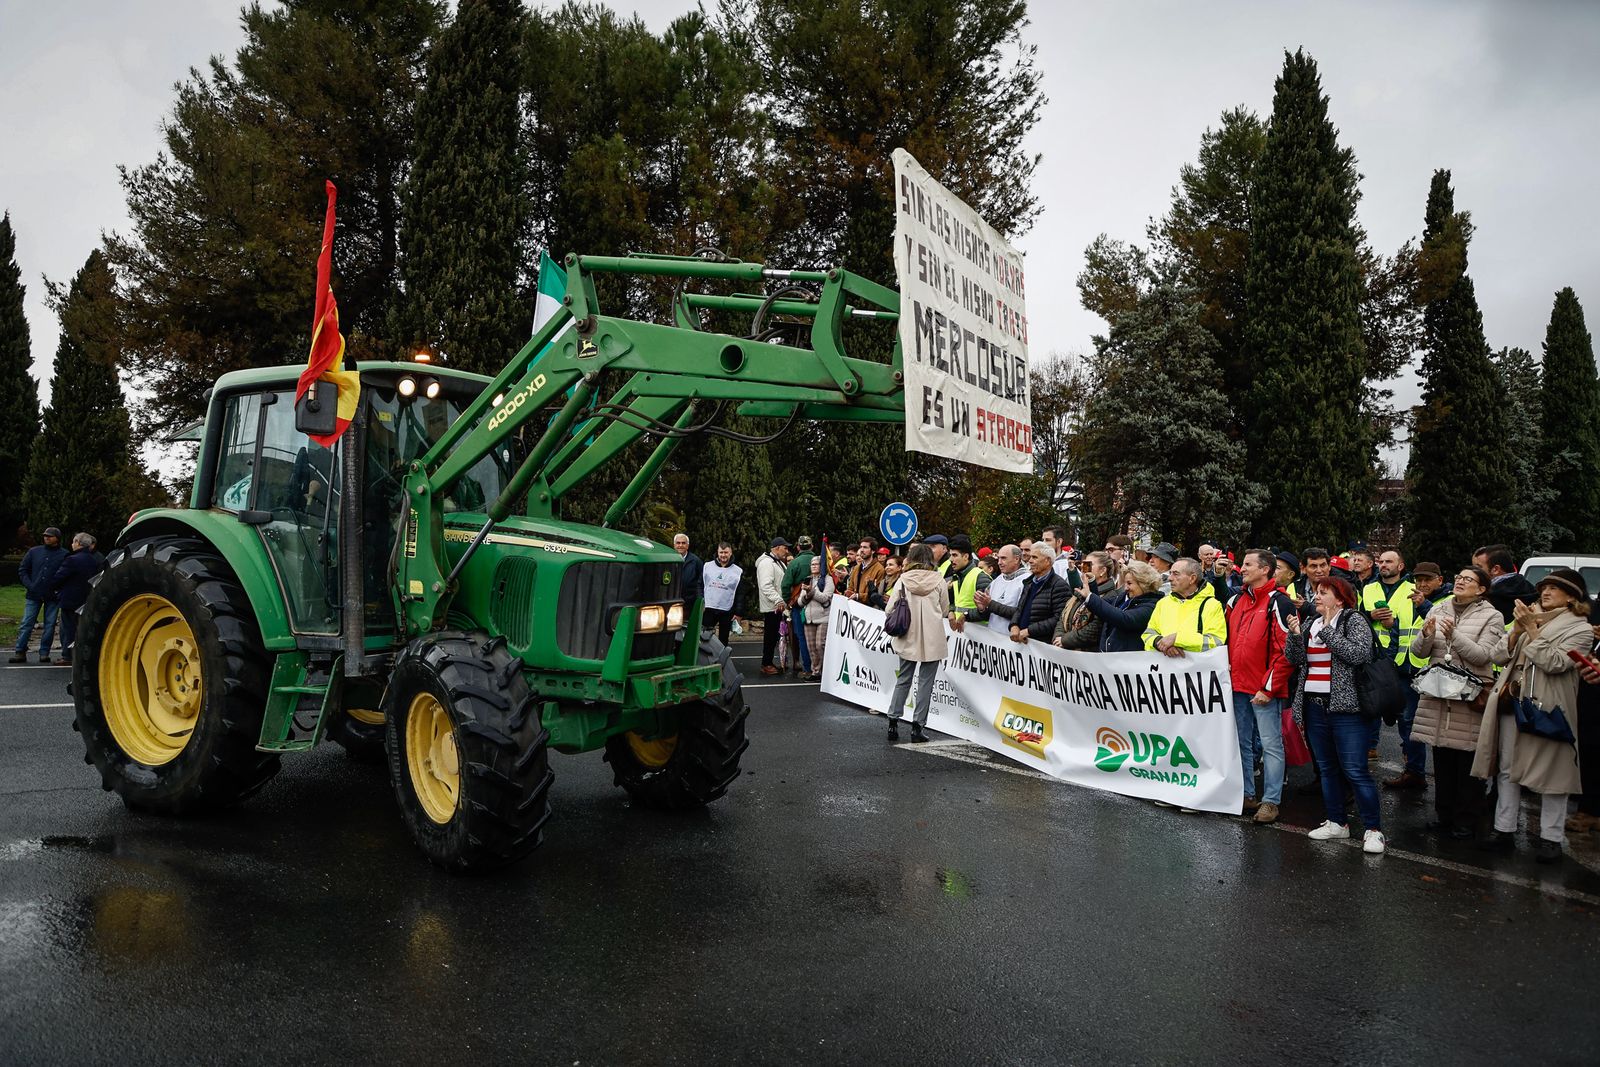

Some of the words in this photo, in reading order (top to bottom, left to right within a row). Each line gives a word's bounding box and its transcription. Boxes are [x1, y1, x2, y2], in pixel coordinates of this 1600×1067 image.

[901, 174, 925, 225] SIN
[928, 196, 950, 245] LAS
[954, 217, 990, 275] MISMAS
[993, 250, 1025, 300] NORMAS
[904, 234, 912, 274] Y
[918, 243, 941, 292] SIN
[943, 263, 959, 304] EL
[962, 275, 994, 325] MISMO
[996, 300, 1028, 345] TRATO
[913, 300, 1027, 407] MERCOSUR
[488, 374, 547, 431] 4000-XD
[922, 385, 944, 428] ES
[951, 397, 970, 437] UN
[977, 407, 1032, 453] ATRACO
[543, 543, 568, 553] 6320
[951, 637, 1025, 687] INSEGURIDAD
[1029, 654, 1118, 711] ALIMENTARIA
[1114, 664, 1226, 715] MAÑANA
[1003, 714, 1044, 735] COAG
[1127, 730, 1199, 768] UPA
[1128, 766, 1198, 788] GRANADA
